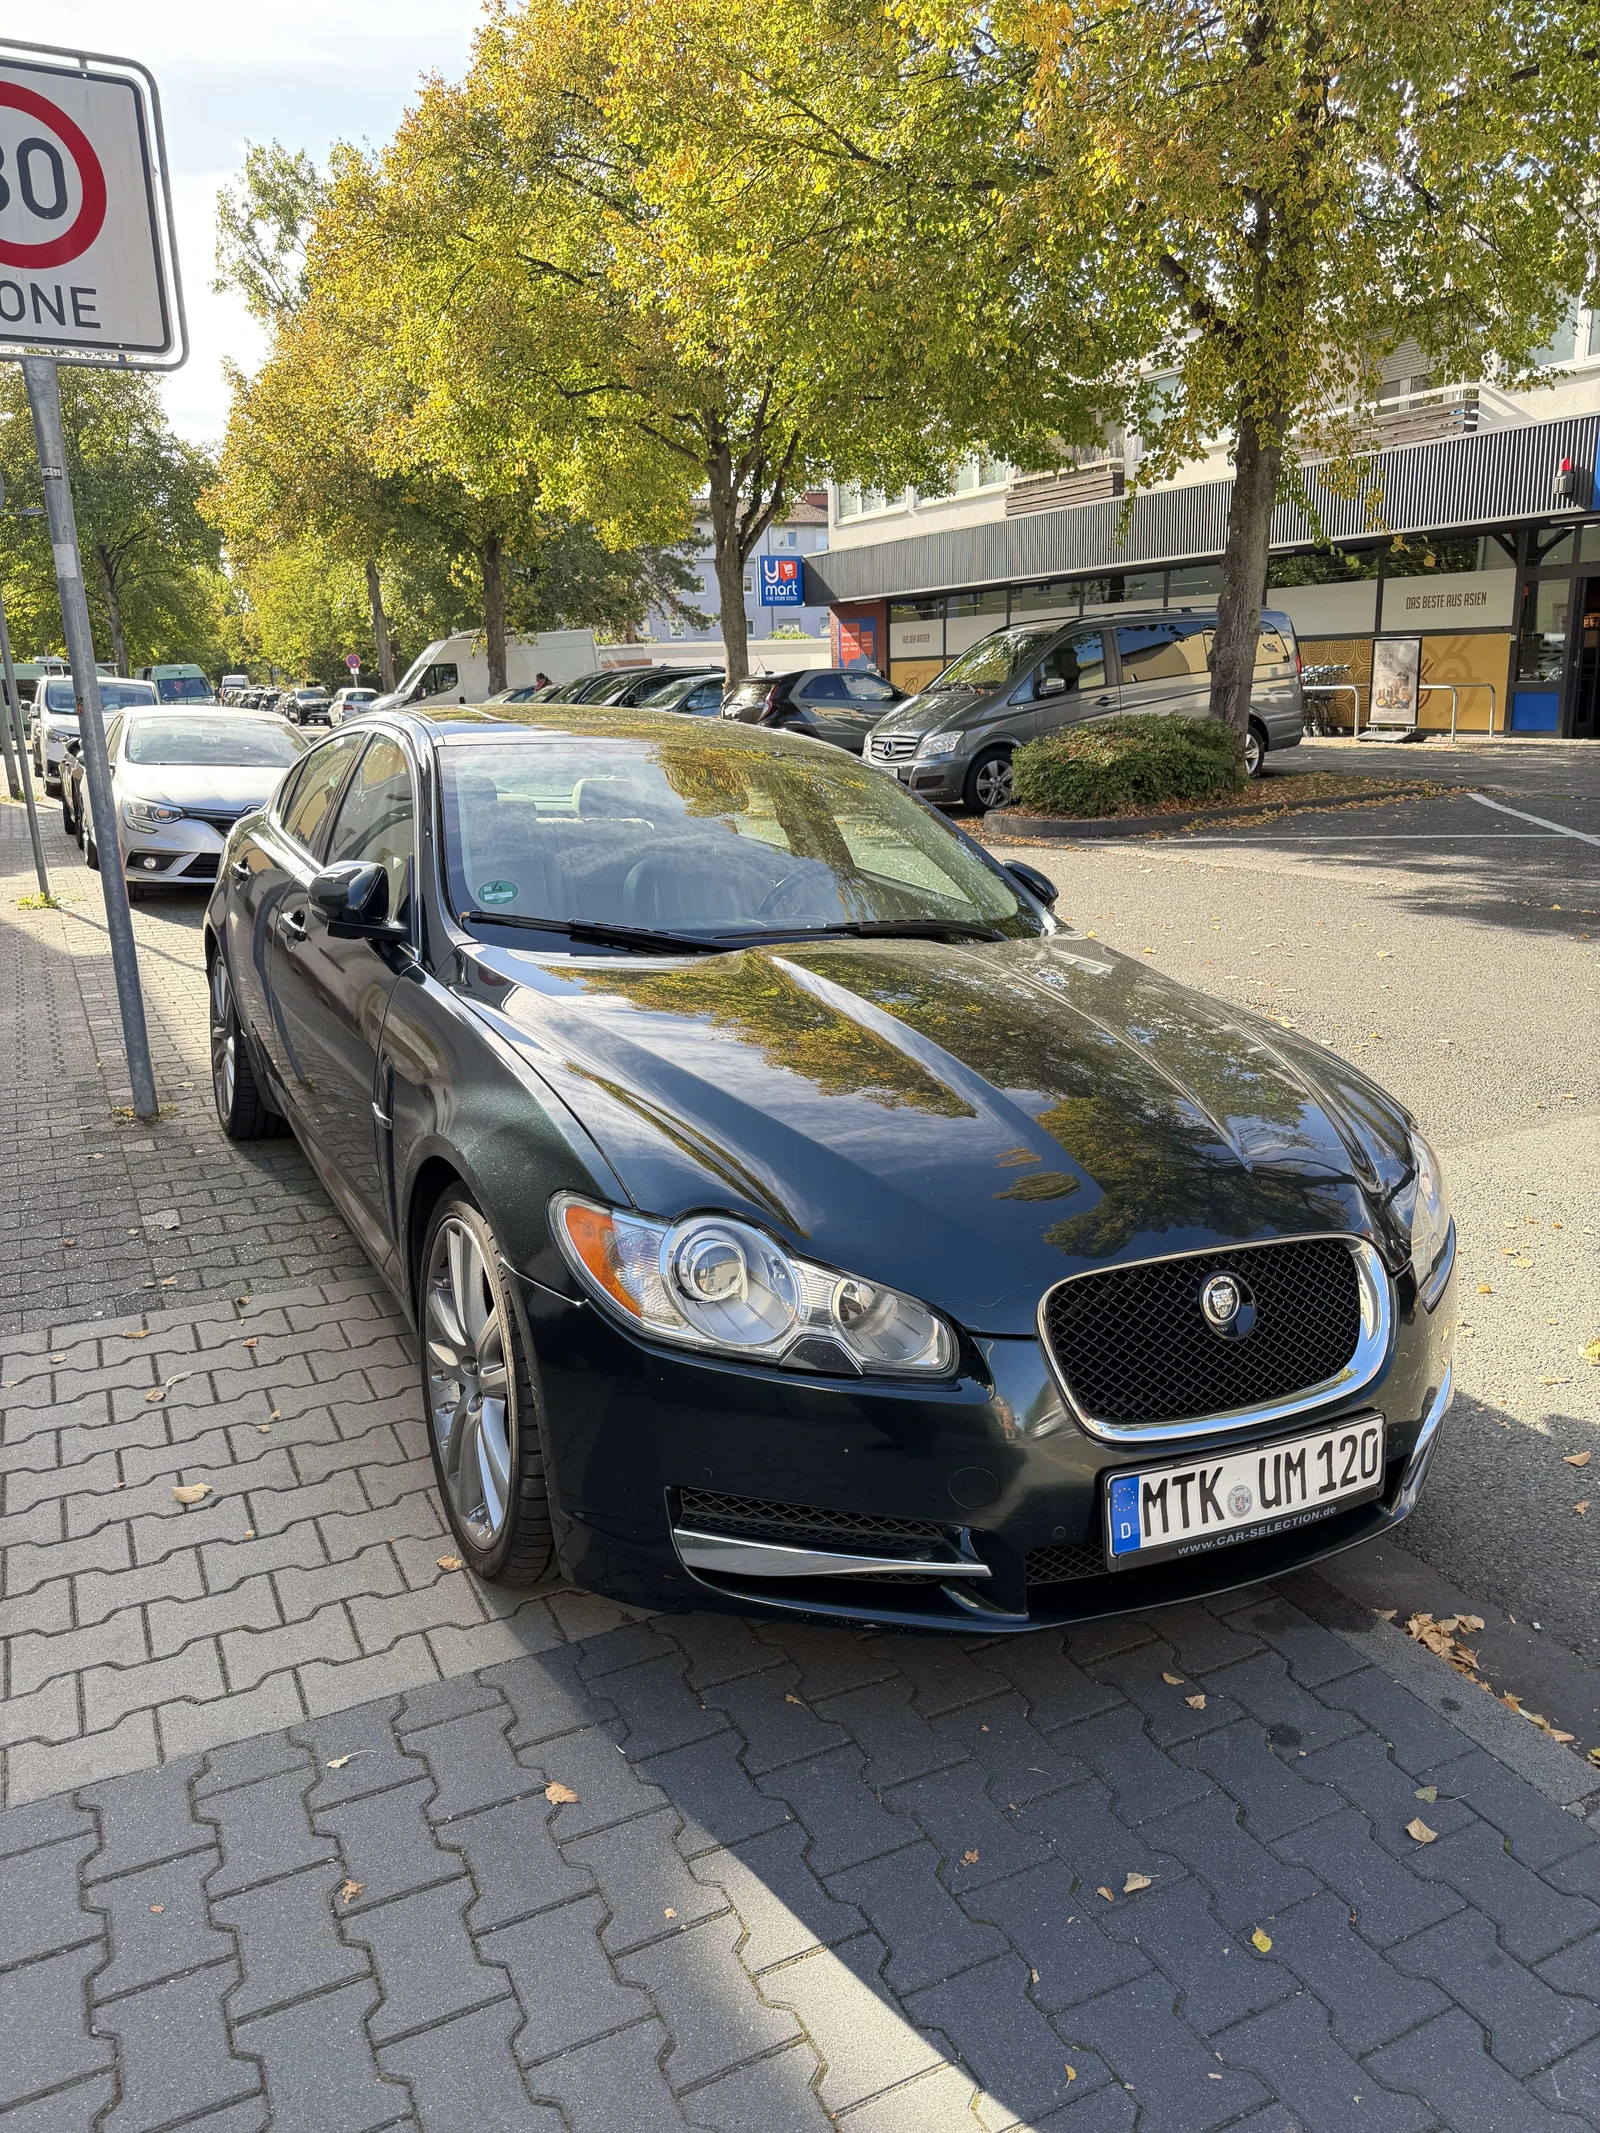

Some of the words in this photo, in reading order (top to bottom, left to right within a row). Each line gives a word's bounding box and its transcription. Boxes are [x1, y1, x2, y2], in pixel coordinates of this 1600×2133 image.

[0, 137, 68, 220] 0
[765, 580, 798, 596] mart
[1406, 596, 1421, 610] DAS
[1422, 594, 1445, 609] BESTE
[1446, 593, 1462, 607] AUS
[1463, 591, 1487, 606] ASIEN
[1142, 1466, 1225, 1538] MTK
[1258, 1447, 1308, 1510] UM
[1316, 1428, 1379, 1496] 120
[1120, 1521, 1132, 1539] D
[1177, 1506, 1337, 1556] www.CAR-SELECTION.de
